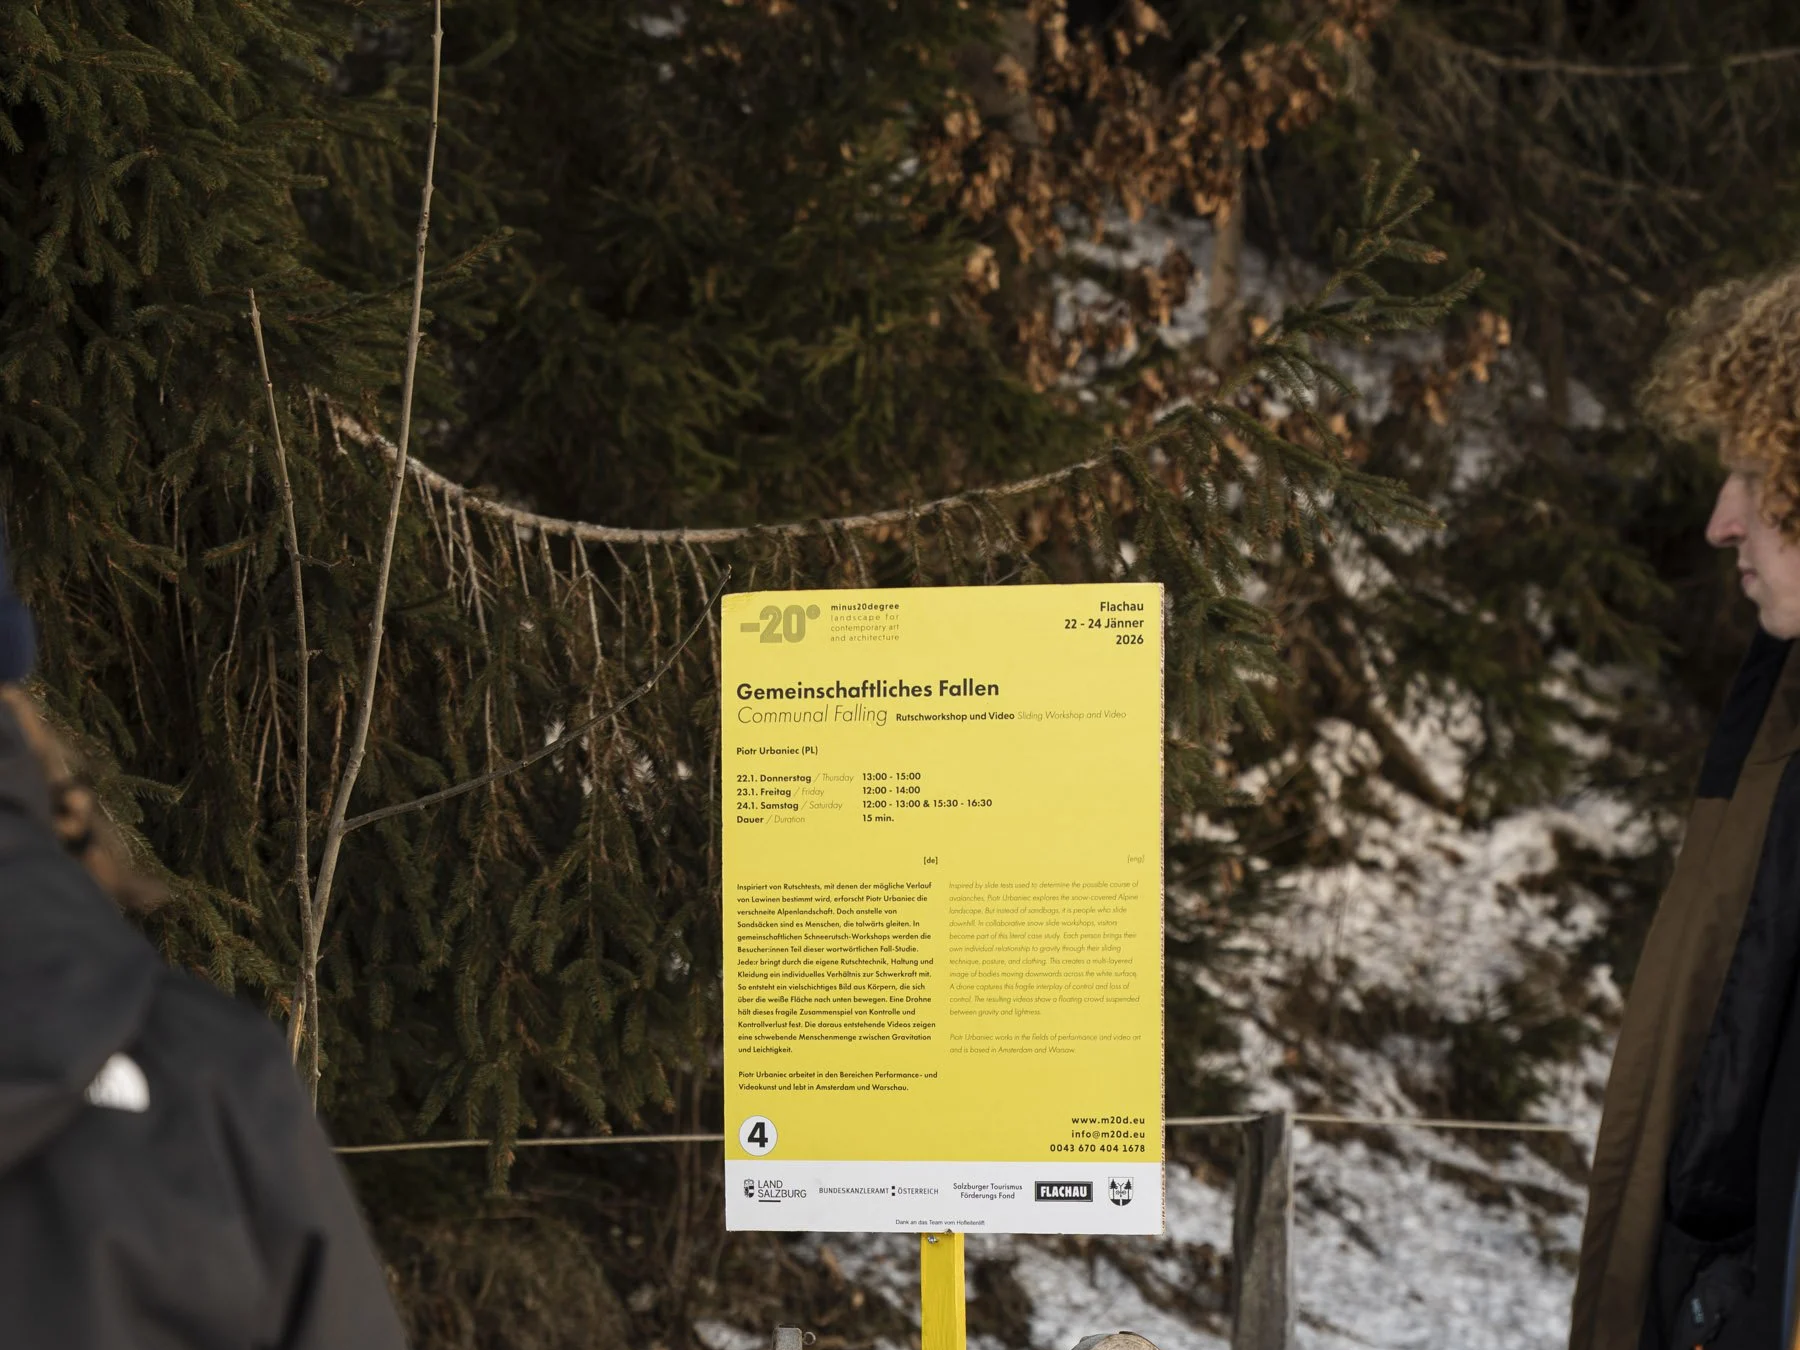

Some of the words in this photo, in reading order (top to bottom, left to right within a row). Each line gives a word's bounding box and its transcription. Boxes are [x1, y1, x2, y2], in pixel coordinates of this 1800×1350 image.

[831, 603, 900, 612] minus20degree
[1100, 601, 1144, 612] Flachau
[831, 614, 880, 622] landscape
[885, 613, 899, 621] for
[831, 624, 886, 632] contemporary
[888, 623, 900, 631] art
[1065, 619, 1077, 629] 22
[1088, 619, 1102, 629] 24
[1104, 618, 1144, 628] Jänner
[831, 634, 846, 642] and
[1116, 635, 1144, 645] 2026
[737, 680, 932, 700] Gemeinschaftliches
[940, 678, 999, 696] Fallen
[738, 704, 829, 724] Communal
[834, 704, 888, 726] Falling
[896, 713, 967, 722] Rutschworkshop
[970, 712, 986, 720] und
[988, 712, 1015, 720] Video
[1017, 710, 1043, 721] Sliding
[1045, 709, 1085, 721] Workshop
[1087, 709, 1102, 719] and
[1103, 709, 1127, 719] Video
[737, 747, 757, 755] Piotr
[759, 746, 799, 755] Urbaniec
[802, 746, 818, 756] (PL)
[760, 775, 811, 784] Donnerstag
[822, 772, 855, 783] Thursday
[863, 773, 887, 781] 13:00
[896, 772, 921, 780] 15:00
[737, 788, 758, 796] 23.1.
[761, 787, 791, 798] Freitag
[801, 786, 825, 797] Friday
[863, 787, 887, 795] 12:00
[896, 786, 920, 794] 14:00
[737, 802, 758, 810] 24.1.
[761, 802, 798, 811] Samstag
[809, 800, 843, 811] Saturday
[863, 800, 887, 808] 12:00
[896, 800, 920, 808] 13:00
[934, 799, 958, 807] 15:30
[968, 799, 992, 807] 16:30
[774, 815, 806, 824] Duration
[863, 814, 872, 822] 15
[875, 813, 894, 822] min.
[924, 857, 938, 865] [de]
[737, 884, 768, 892] Inspiriert
[873, 882, 904, 891] mögliche
[833, 895, 864, 903] erforscht
[866, 895, 882, 903] Piotr
[777, 907, 835, 917] Alpenlandschaft.
[837, 907, 854, 915] Doch
[856, 907, 883, 915] anstelle
[886, 920, 911, 929] gleiten.
[737, 933, 802, 942] gemeinschaftlichen
[804, 933, 890, 941] Schneerutsch-Workshops
[826, 944, 878, 953] wortwörtlichen
[760, 958, 781, 967] bringt
[816, 958, 839, 967] eigene
[841, 958, 889, 966] Rutschtechnik,
[891, 958, 918, 966] Haltung
[738, 971, 768, 979] Kleidung
[789, 1071, 816, 1079] arbeitet
[778, 1083, 792, 1091] und
[816, 1083, 855, 1091] Amsterdam
[1072, 1116, 1145, 1124] www.m20d.eu
[747, 1122, 768, 1148] 4
[1072, 1130, 1145, 1139] info@m20d.eu
[1050, 1144, 1074, 1152] 0043
[1078, 1144, 1096, 1152] 670
[1100, 1144, 1119, 1152] 404
[1123, 1144, 1145, 1152] 1678
[758, 1180, 783, 1189] LAND
[953, 1183, 989, 1192] Salzburger
[758, 1190, 806, 1198] SALZBURG
[898, 1187, 938, 1195] ÖSTERREICH
[961, 1191, 997, 1200] Förderungs
[1040, 1186, 1087, 1198] FLACHAU
